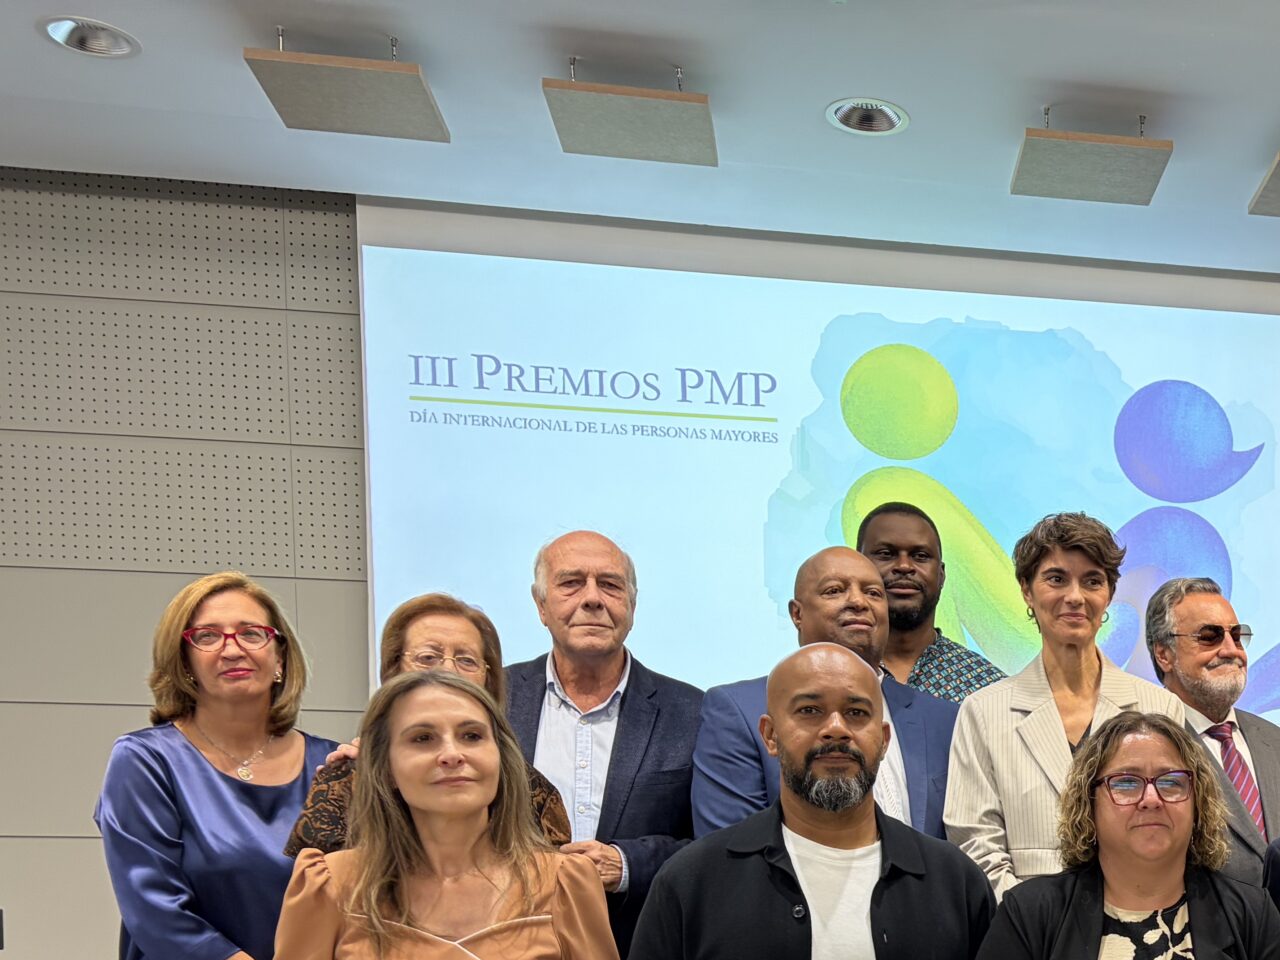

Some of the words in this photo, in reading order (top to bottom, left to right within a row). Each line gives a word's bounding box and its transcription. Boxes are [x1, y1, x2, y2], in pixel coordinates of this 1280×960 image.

[408, 353, 458, 388] III
[675, 367, 778, 408] PMP
[409, 408, 439, 425] DÍA
[442, 412, 572, 433] INTERNACIONAL
[576, 421, 598, 434] DE
[600, 423, 628, 436] LAS
[631, 424, 707, 440] PERSONAS
[710, 427, 779, 444] MAYORES
